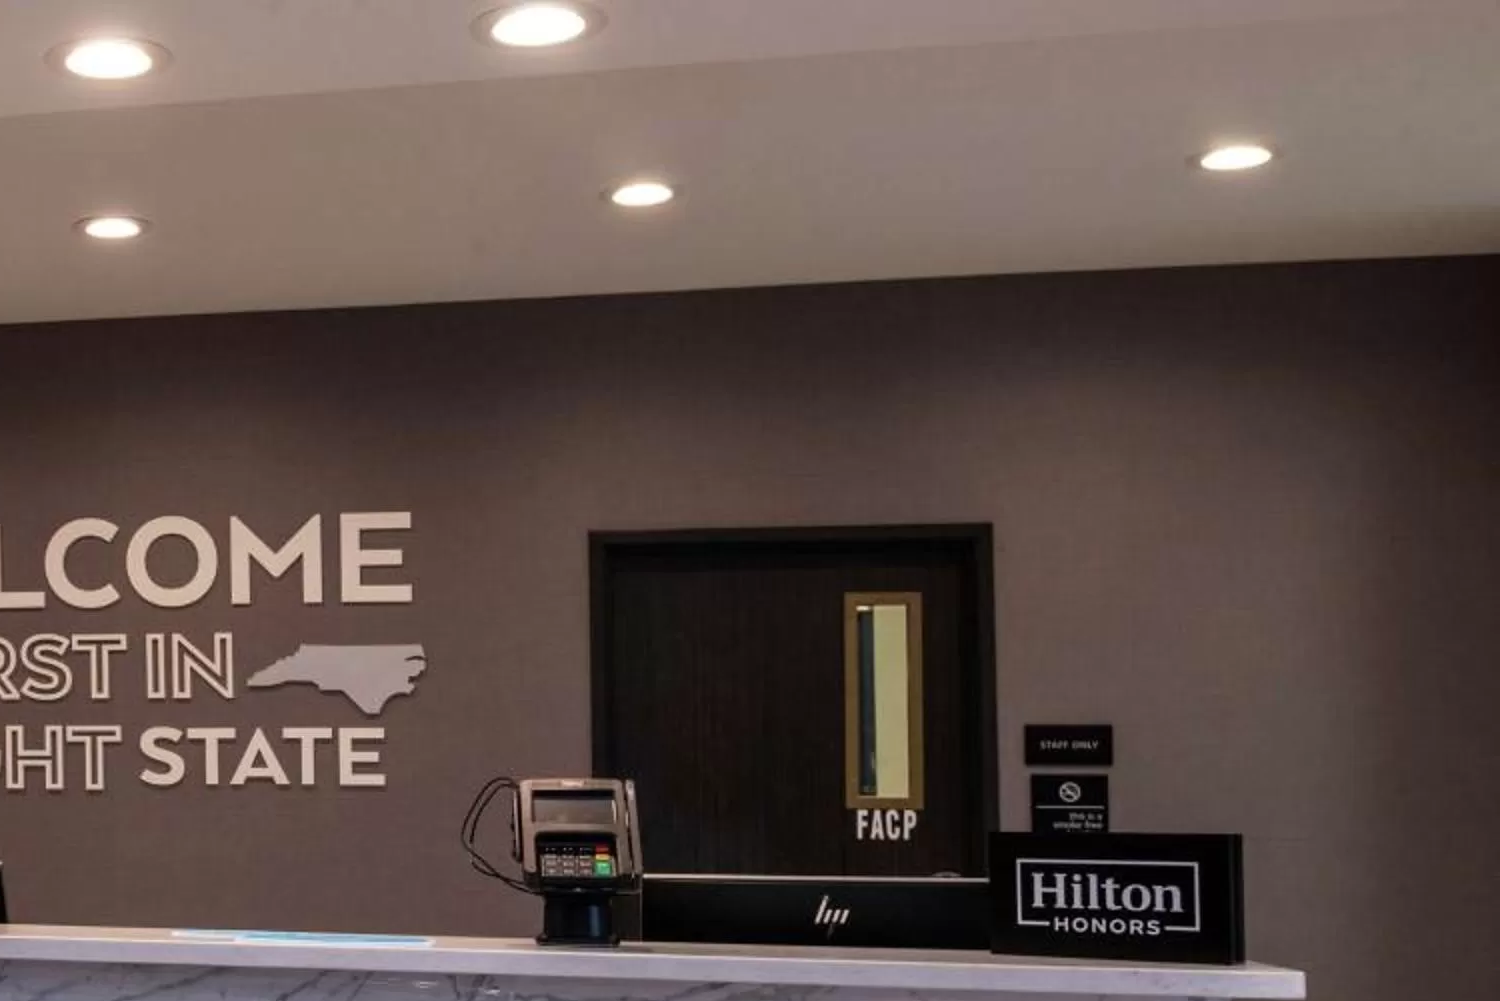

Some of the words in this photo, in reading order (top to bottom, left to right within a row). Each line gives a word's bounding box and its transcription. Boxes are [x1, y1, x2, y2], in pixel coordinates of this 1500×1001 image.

[145, 631, 235, 701] IN
[138, 725, 387, 788] STATE
[856, 808, 918, 841] FACP
[1031, 871, 1184, 913] Hilton
[1053, 916, 1162, 936] HONORS
